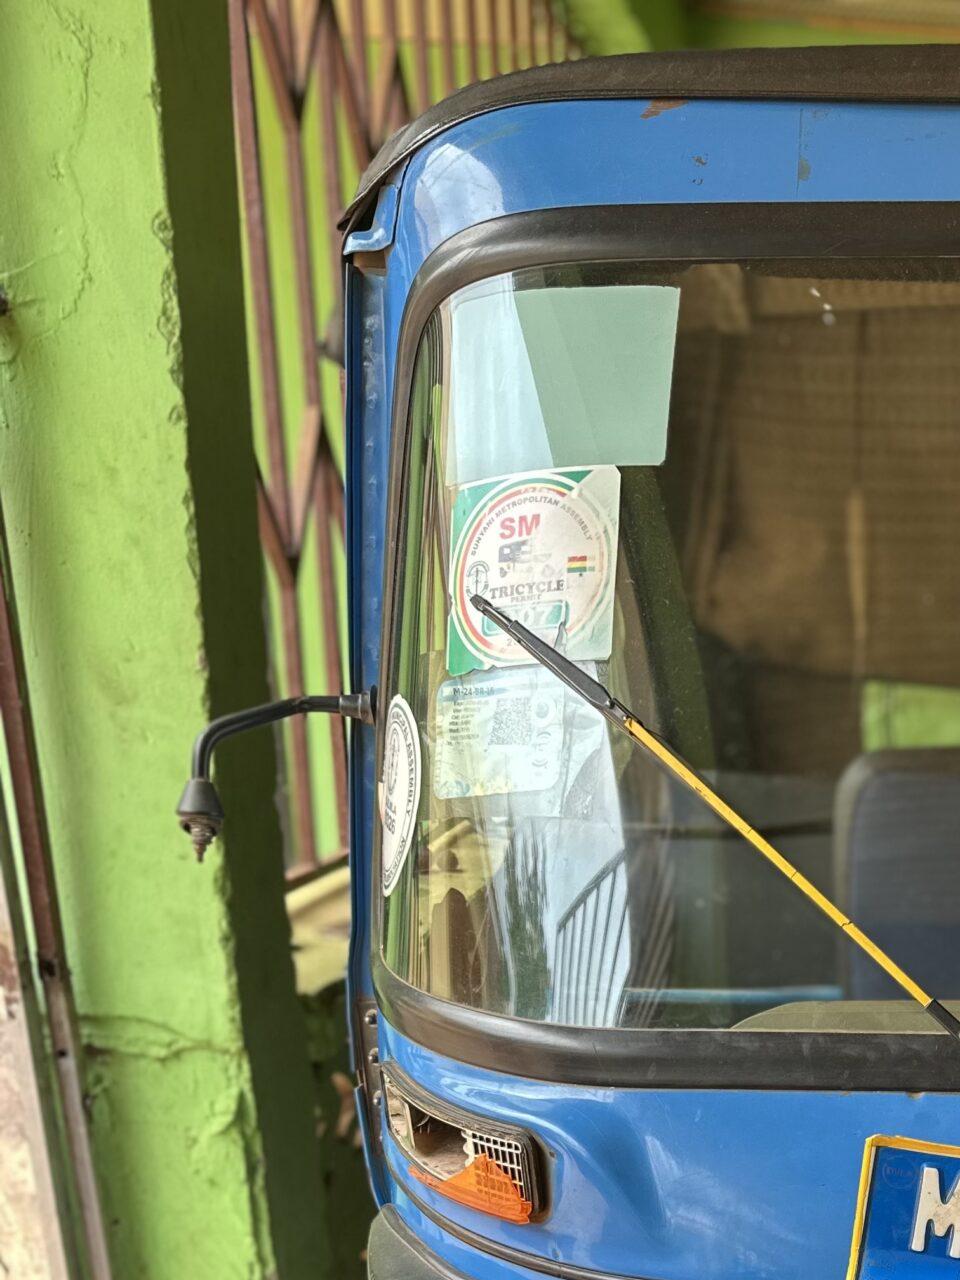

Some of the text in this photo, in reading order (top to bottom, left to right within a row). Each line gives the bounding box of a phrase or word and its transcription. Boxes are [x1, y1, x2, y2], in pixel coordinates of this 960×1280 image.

[471, 495, 593, 556] SUNYANI METROPOLITAN ASSEMBLY
[489, 579, 565, 600] TRICYCLE
